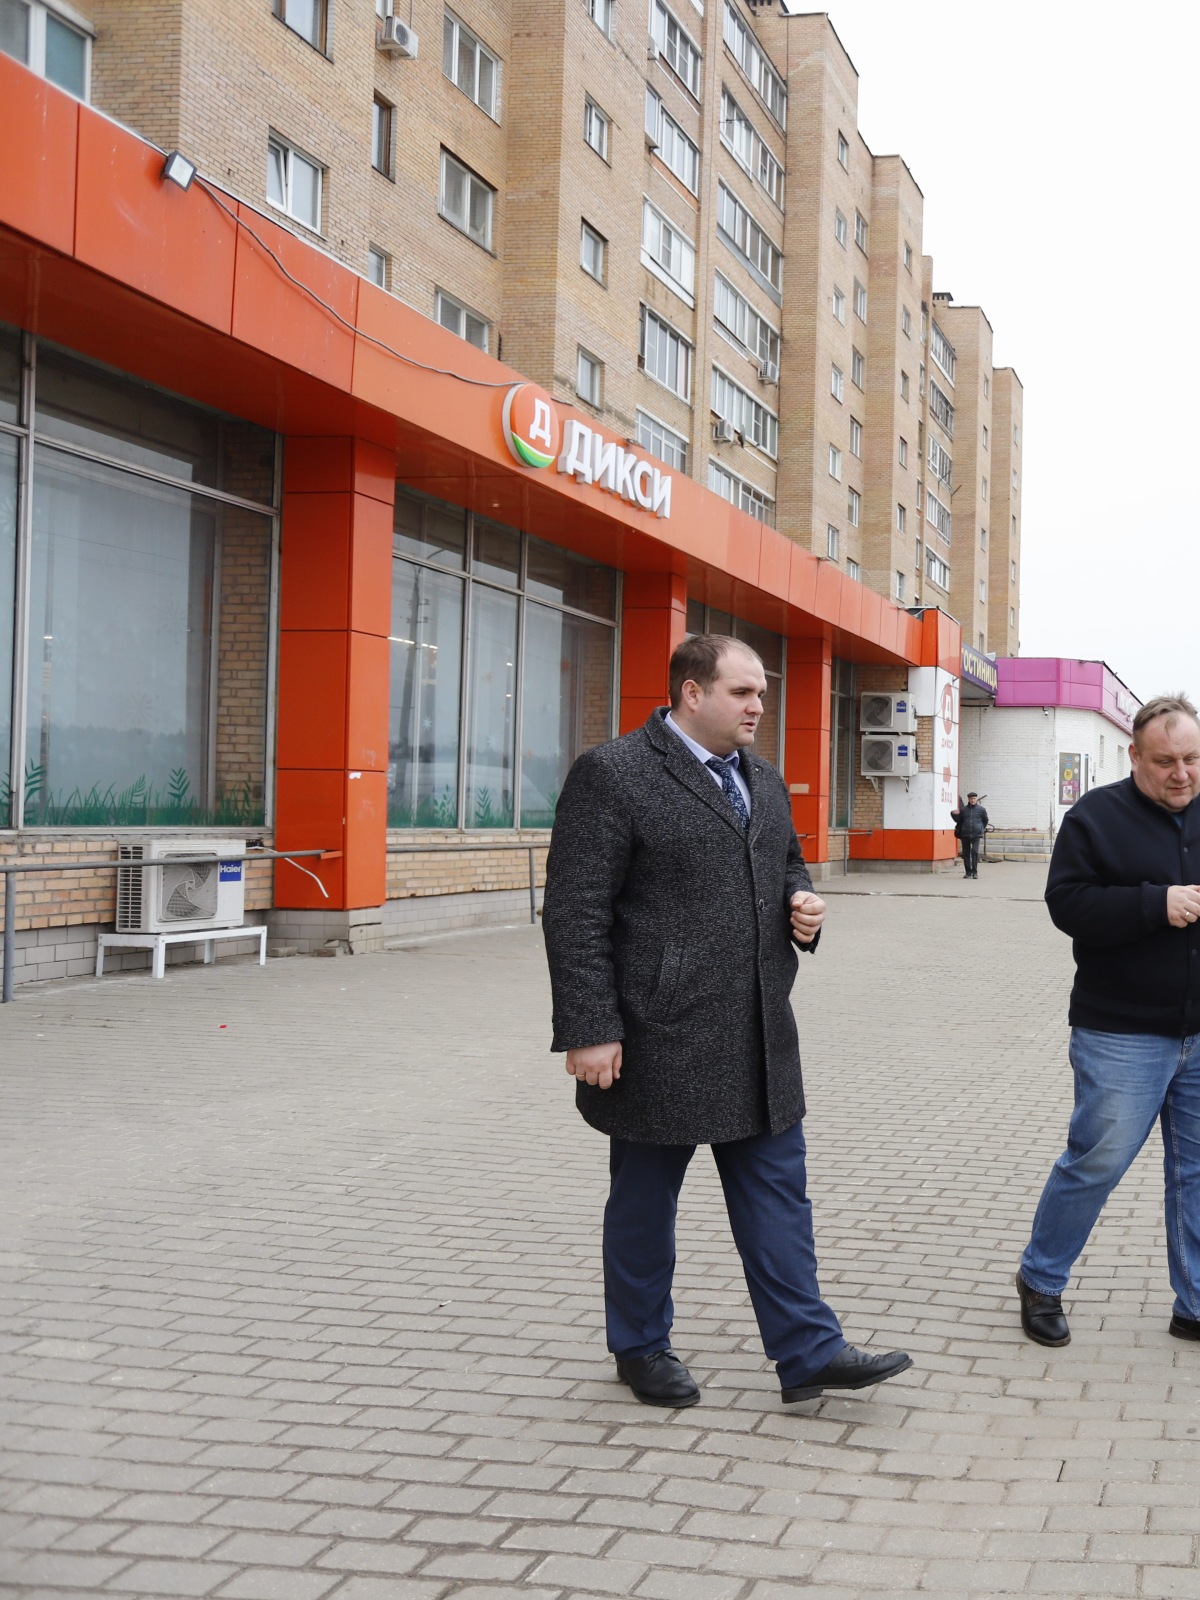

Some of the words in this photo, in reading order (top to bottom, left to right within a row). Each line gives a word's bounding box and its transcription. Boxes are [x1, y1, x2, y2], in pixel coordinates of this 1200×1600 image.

[529, 398, 551, 448] Д
[559, 419, 672, 518] ДИКСИ
[220, 864, 242, 873] Haier
